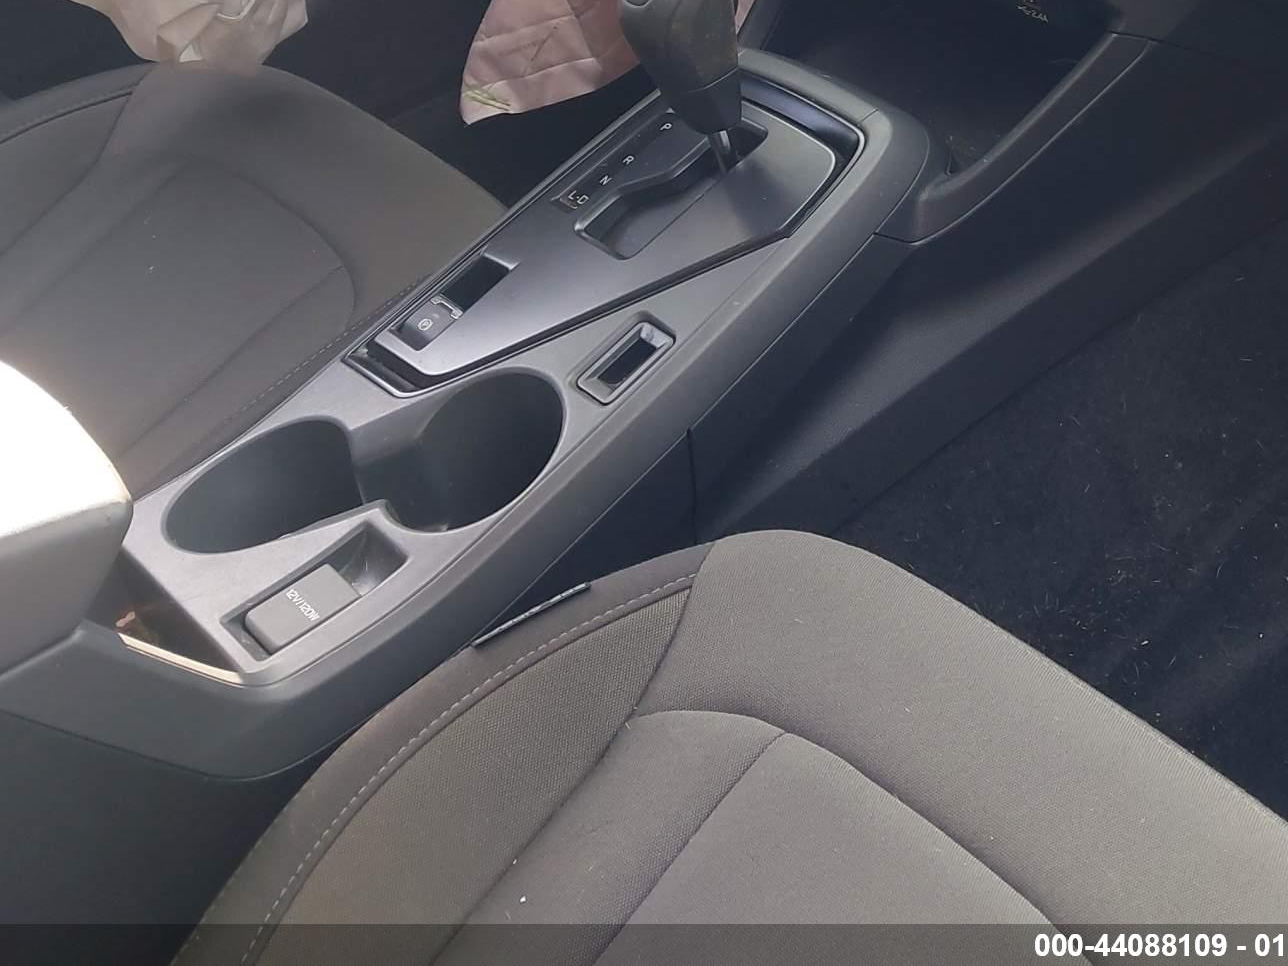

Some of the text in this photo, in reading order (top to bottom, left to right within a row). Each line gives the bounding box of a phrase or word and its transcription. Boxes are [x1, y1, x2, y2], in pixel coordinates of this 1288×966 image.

[660, 123, 672, 131] P
[622, 155, 635, 165] R
[600, 175, 612, 186] N
